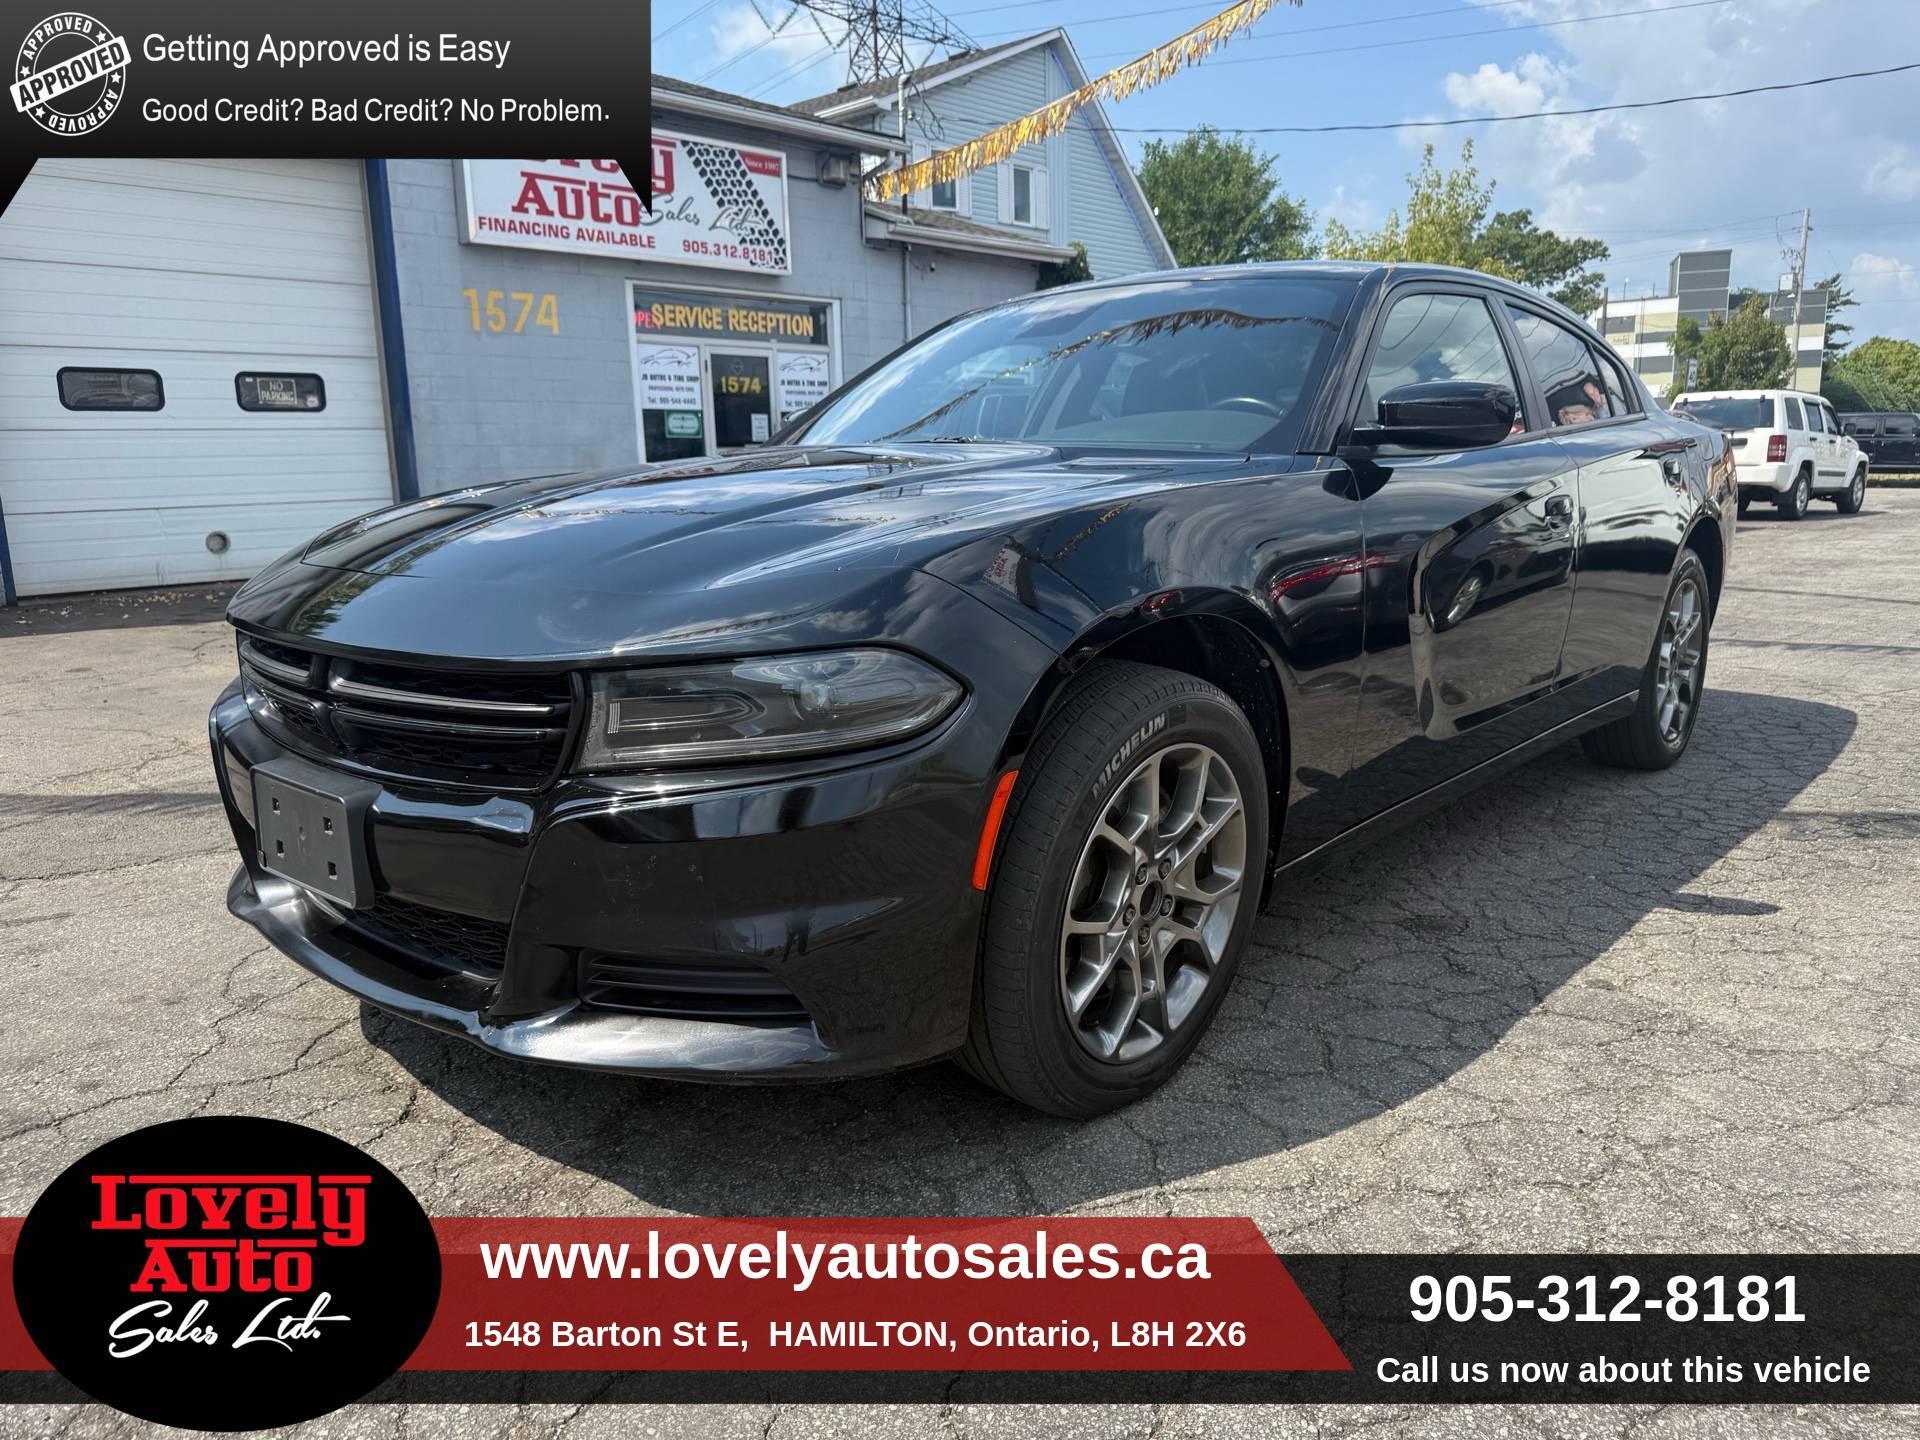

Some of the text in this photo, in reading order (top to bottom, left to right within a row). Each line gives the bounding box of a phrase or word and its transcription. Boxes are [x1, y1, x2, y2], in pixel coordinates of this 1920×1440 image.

[511, 170, 641, 228] Auto
[478, 216, 656, 249] FINANCING AVAILABLE
[683, 239, 774, 262] 905.312.8181
[463, 288, 560, 336] 1574
[651, 303, 814, 337] SERVICE RECEPTION
[269, 381, 284, 391] NO
[720, 376, 762, 394] 1574
[1092, 713, 1167, 800] MICHELIN
